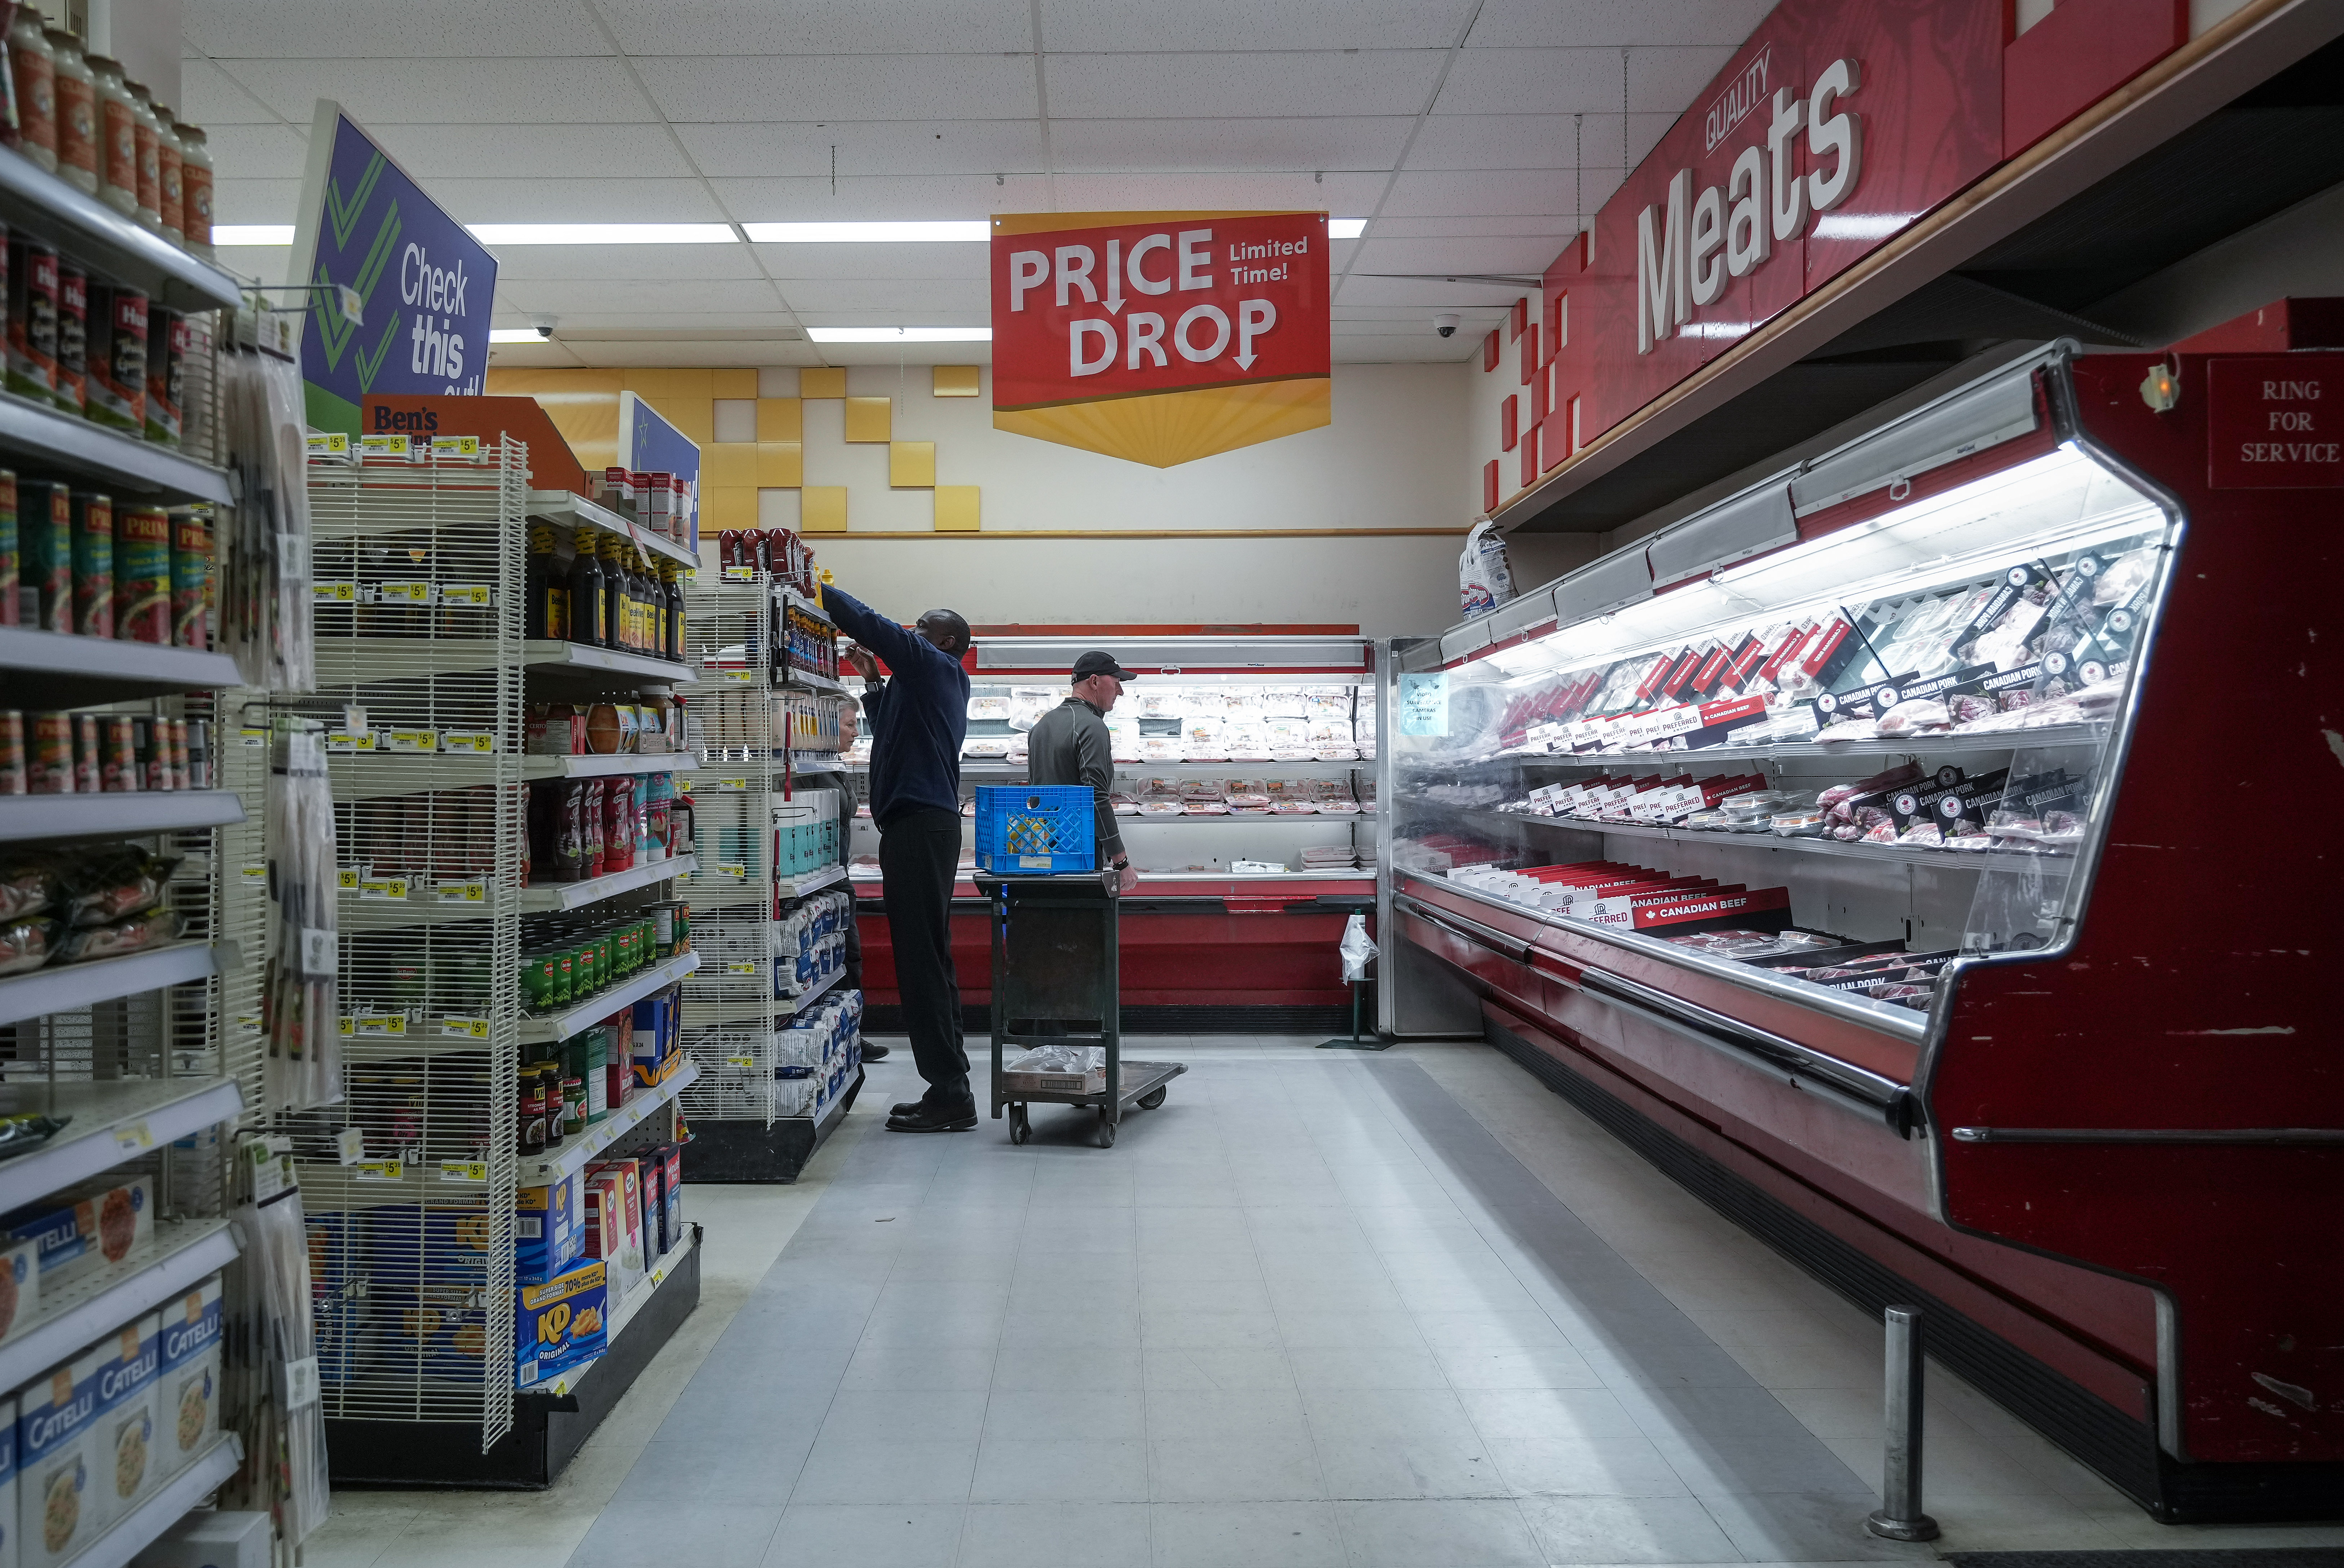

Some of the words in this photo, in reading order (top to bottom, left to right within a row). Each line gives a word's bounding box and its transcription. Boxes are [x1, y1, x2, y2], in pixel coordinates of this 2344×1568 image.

[1706, 48, 1770, 151] QUALITY
[1638, 58, 1861, 355] Meats
[1230, 236, 1307, 261] Limited
[401, 242, 467, 317] Check
[1010, 229, 1212, 315] PRICE
[1230, 263, 1287, 285] Time!
[412, 314, 463, 379] this
[1070, 299, 1276, 377] DROP
[2262, 381, 2320, 400] RING
[374, 406, 438, 430] Ben's
[2269, 412, 2314, 431] FOR
[2241, 443, 2340, 462] SERVICE
[127, 516, 168, 535] PRIM
[182, 528, 204, 547] PRI
[630, 608, 643, 618] eeHive
[1983, 669, 2020, 691] CANADIAN
[2021, 665, 2042, 679] PORK
[1839, 688, 1871, 705] CANADIAN
[1901, 680, 1938, 700] CANADIAN
[1938, 676, 1958, 690] PORK
[1710, 708, 1736, 719] CANADIAN
[1737, 705, 1749, 713] BEEF
[1603, 727, 1625, 739] PREFER
[1663, 717, 1697, 731] PREFERRED
[1531, 733, 1551, 742] PREFERR
[1554, 733, 1572, 742] PREFER
[1576, 730, 1598, 740] PREFERR
[1712, 787, 1740, 799] CANADIAN
[1739, 783, 1751, 791] BEEF
[1919, 780, 1936, 793] PORK
[1919, 789, 1955, 806] CANADIAN
[1955, 783, 1974, 796] PORK
[2026, 789, 2064, 805] CANADIAN
[2065, 782, 2085, 795] PORK
[1534, 795, 1551, 804] PREFER
[1555, 797, 1573, 807] PREFER
[1578, 797, 1599, 808] PREFER
[1604, 796, 1627, 809] PREFERR
[1665, 797, 1700, 813] PREFERRED
[1575, 882, 1611, 890] NADIAN
[1631, 895, 1678, 907] ANADIAN
[1660, 902, 1717, 917] CANADIAN
[1720, 898, 1746, 909] BEEF
[1589, 912, 1627, 924] FERRED
[536, 1088, 544, 1099] VH
[668, 1159, 680, 1176] Minute
[647, 1175, 657, 1192] Minute
[39, 1224, 76, 1253] TELLI
[458, 1255, 489, 1265] ORIGIN
[539, 1286, 554, 1295] SUPER
[555, 1282, 564, 1291] SIZE
[565, 1277, 581, 1293] 70%
[530, 1295, 546, 1305] GRAND
[547, 1289, 564, 1299] FORMAT
[537, 1303, 570, 1344] KD
[168, 1314, 218, 1359] CATELLI
[539, 1341, 570, 1360] ORIGINAL
[102, 1350, 157, 1399] CATELLI
[29, 1393, 93, 1447] CATELLI
